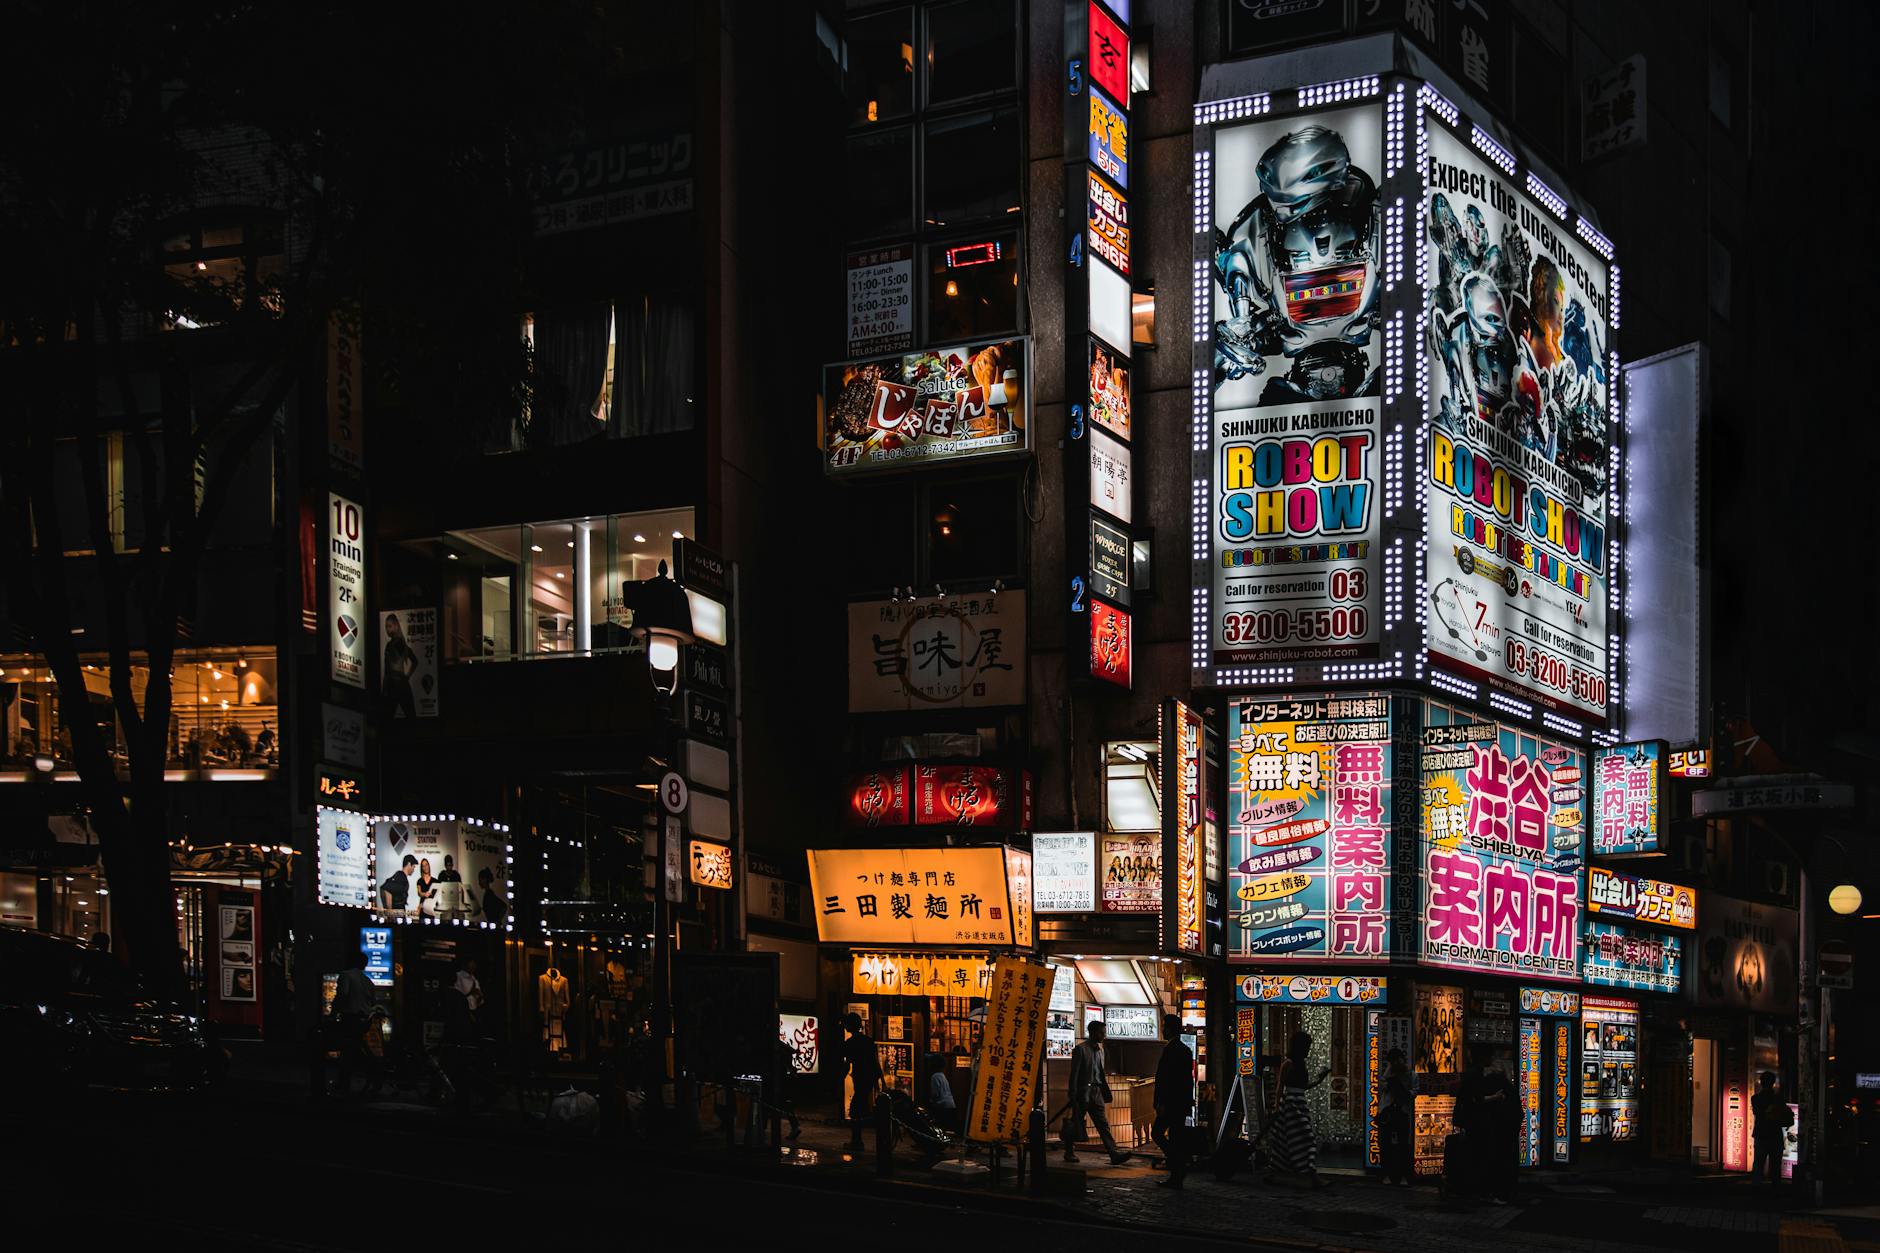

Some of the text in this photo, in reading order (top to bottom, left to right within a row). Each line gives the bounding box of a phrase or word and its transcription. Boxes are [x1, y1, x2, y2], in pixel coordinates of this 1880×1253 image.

[1068, 59, 1082, 95] 5
[1089, 95, 1127, 164] 麻雀
[1097, 148, 1120, 178] 5F
[1090, 179, 1127, 223] 出会い
[1094, 208, 1127, 248] カフェ
[1429, 156, 1605, 322] Expect the unexpected
[1070, 232, 1082, 267] 4
[1089, 229, 1129, 271] 受付6F
[852, 273, 908, 292] 11:00-15:00
[873, 266, 894, 276] Lunch
[852, 294, 908, 313] 16:00-23:30
[881, 287, 903, 296] Dinner
[852, 321, 895, 338] AM4:00
[918, 377, 965, 395] Salute
[877, 384, 984, 438] じゃぽん
[1071, 403, 1084, 439] 3
[1221, 408, 1374, 438] SHINJUKU KABUKICHO
[830, 443, 955, 467] 4F TEL03-6712-7342
[1091, 452, 1128, 485] 朝陽亭
[1226, 435, 1369, 490] ROBOT
[1467, 415, 1581, 502] SHINJUKU KABUKICHO
[1226, 483, 1367, 537] SHOW
[1433, 431, 1526, 525] ROBOT
[1530, 491, 1604, 571] SHOW
[333, 499, 359, 541] 10
[332, 537, 361, 563] min
[1223, 540, 1369, 567] ROBOT RESTAURANT
[1452, 504, 1504, 556] ROBOT
[1506, 536, 1591, 600] RESTAURANT
[333, 557, 361, 579] Training
[333, 568, 355, 584] Studio
[1507, 573, 1516, 588] 16
[339, 586, 352, 603] 2F
[1071, 575, 1085, 612] 2
[1226, 571, 1364, 599] Call for reservation 03
[1454, 579, 1478, 597] Shinjuku
[1226, 607, 1365, 642] 3200-5500
[425, 645, 434, 658] 2F
[872, 628, 1013, 676] 旨味屋
[1480, 641, 1501, 657] Shibuya
[1524, 618, 1595, 663] Call for reservation
[1232, 647, 1359, 662] www.shinjuku-robot.com
[1505, 638, 1606, 706] 03-3200-5500
[1241, 698, 1387, 721] インターネット無料検索!!
[1239, 733, 1288, 752] すべて
[1295, 722, 1387, 742] お店選びの決定版!!
[1423, 723, 1496, 743] インターネット無料検索!!
[921, 766, 937, 778] 2F
[1248, 751, 1322, 791] 無料
[1689, 768, 1704, 776] 6F
[668, 778, 681, 808] 8
[1423, 787, 1448, 806] すべて
[1466, 743, 1550, 851] 渋谷
[1602, 755, 1625, 847] 案内所
[1627, 770, 1649, 828] 無料
[1241, 800, 1298, 823] グルメ情報
[1430, 804, 1468, 840] 無料
[1255, 821, 1326, 845] 優良風俗情報
[1248, 847, 1313, 872] 飲み屋情報
[1333, 744, 1387, 955] 無料案内所
[1470, 835, 1544, 862] SHIBUYA
[856, 871, 956, 887] つけ麺専門店
[1243, 875, 1307, 898] カフェ情報
[1591, 873, 1636, 907] 出会い
[1659, 885, 1672, 896] 6F
[823, 893, 983, 920] 三田製麺所
[1240, 903, 1304, 927] タウン情報
[1425, 848, 1578, 960] 案内所
[1636, 893, 1672, 921] カフェ
[955, 930, 1006, 941] 渋谷道玄坂店
[1186, 930, 1199, 950] 6F
[1252, 930, 1323, 950] プレイスポット情報
[1426, 940, 1574, 971] INFORMATION CENTER
[1600, 932, 1664, 969] 無料案内所
[1261, 976, 1284, 985] トイレ
[1308, 977, 1332, 986] タバコ
[1263, 987, 1377, 1000] OK OK OK
[1581, 1112, 1612, 1137] 出会い
